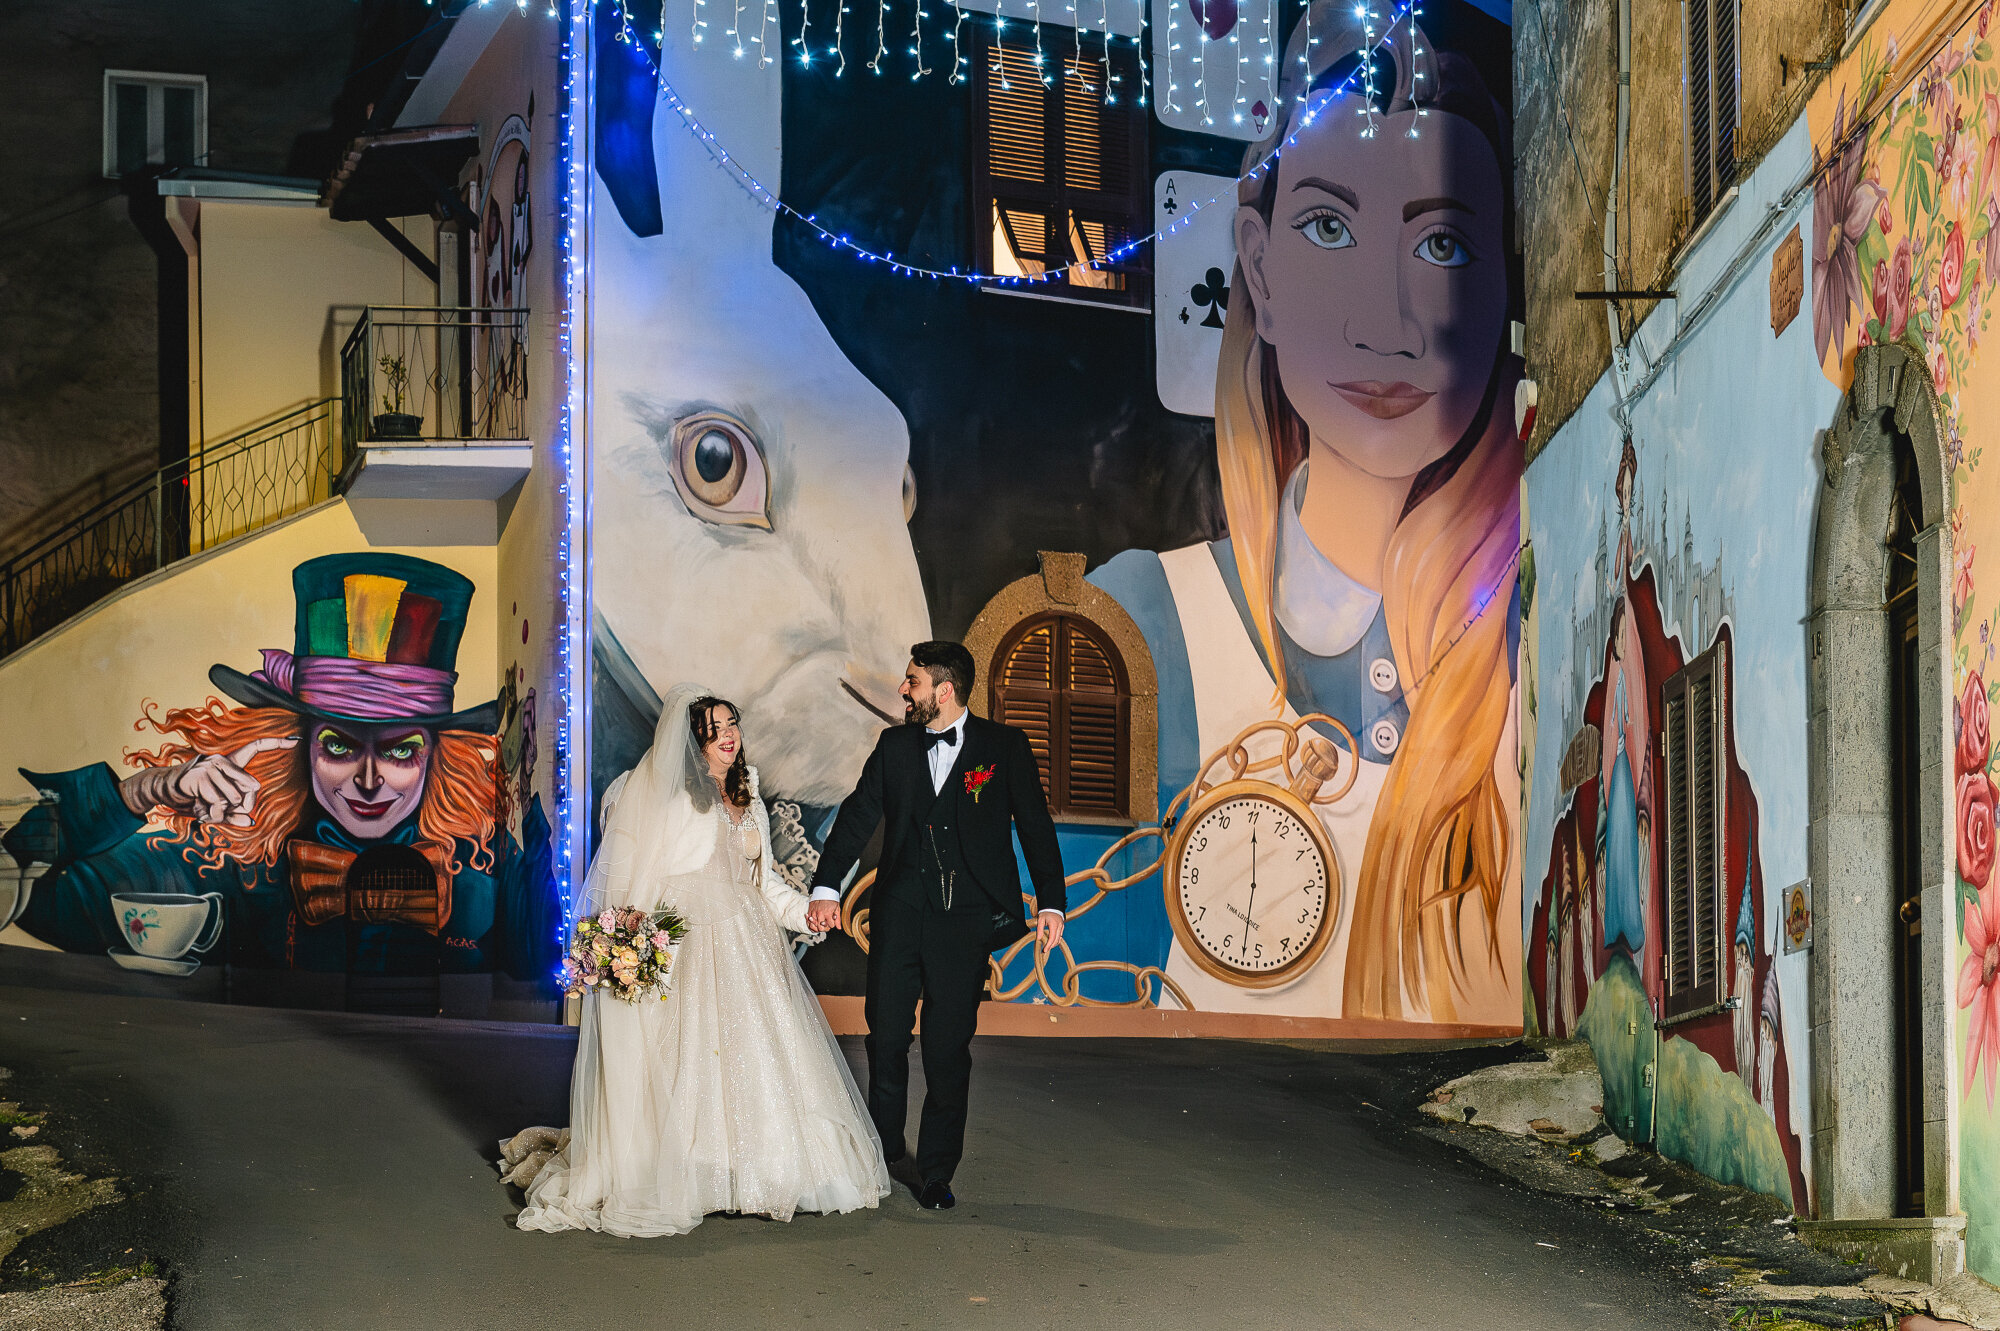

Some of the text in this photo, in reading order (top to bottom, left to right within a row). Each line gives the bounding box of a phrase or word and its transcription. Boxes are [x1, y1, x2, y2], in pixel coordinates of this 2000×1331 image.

[1166, 178, 1177, 195] A
[1811, 630, 1822, 659] 18
[1218, 815, 1231, 830] 10
[1247, 810, 1260, 825] 11
[1273, 821, 1290, 840] 12
[1196, 837, 1208, 852] 9
[1295, 850, 1305, 861] 1
[1190, 867, 1199, 885] 8
[1303, 879, 1316, 895] 2
[1198, 906, 1207, 921] 7
[1297, 908, 1310, 924] 3
[1223, 934, 1233, 948] 6
[1279, 937, 1290, 952] 4
[1253, 943, 1263, 959] 5
